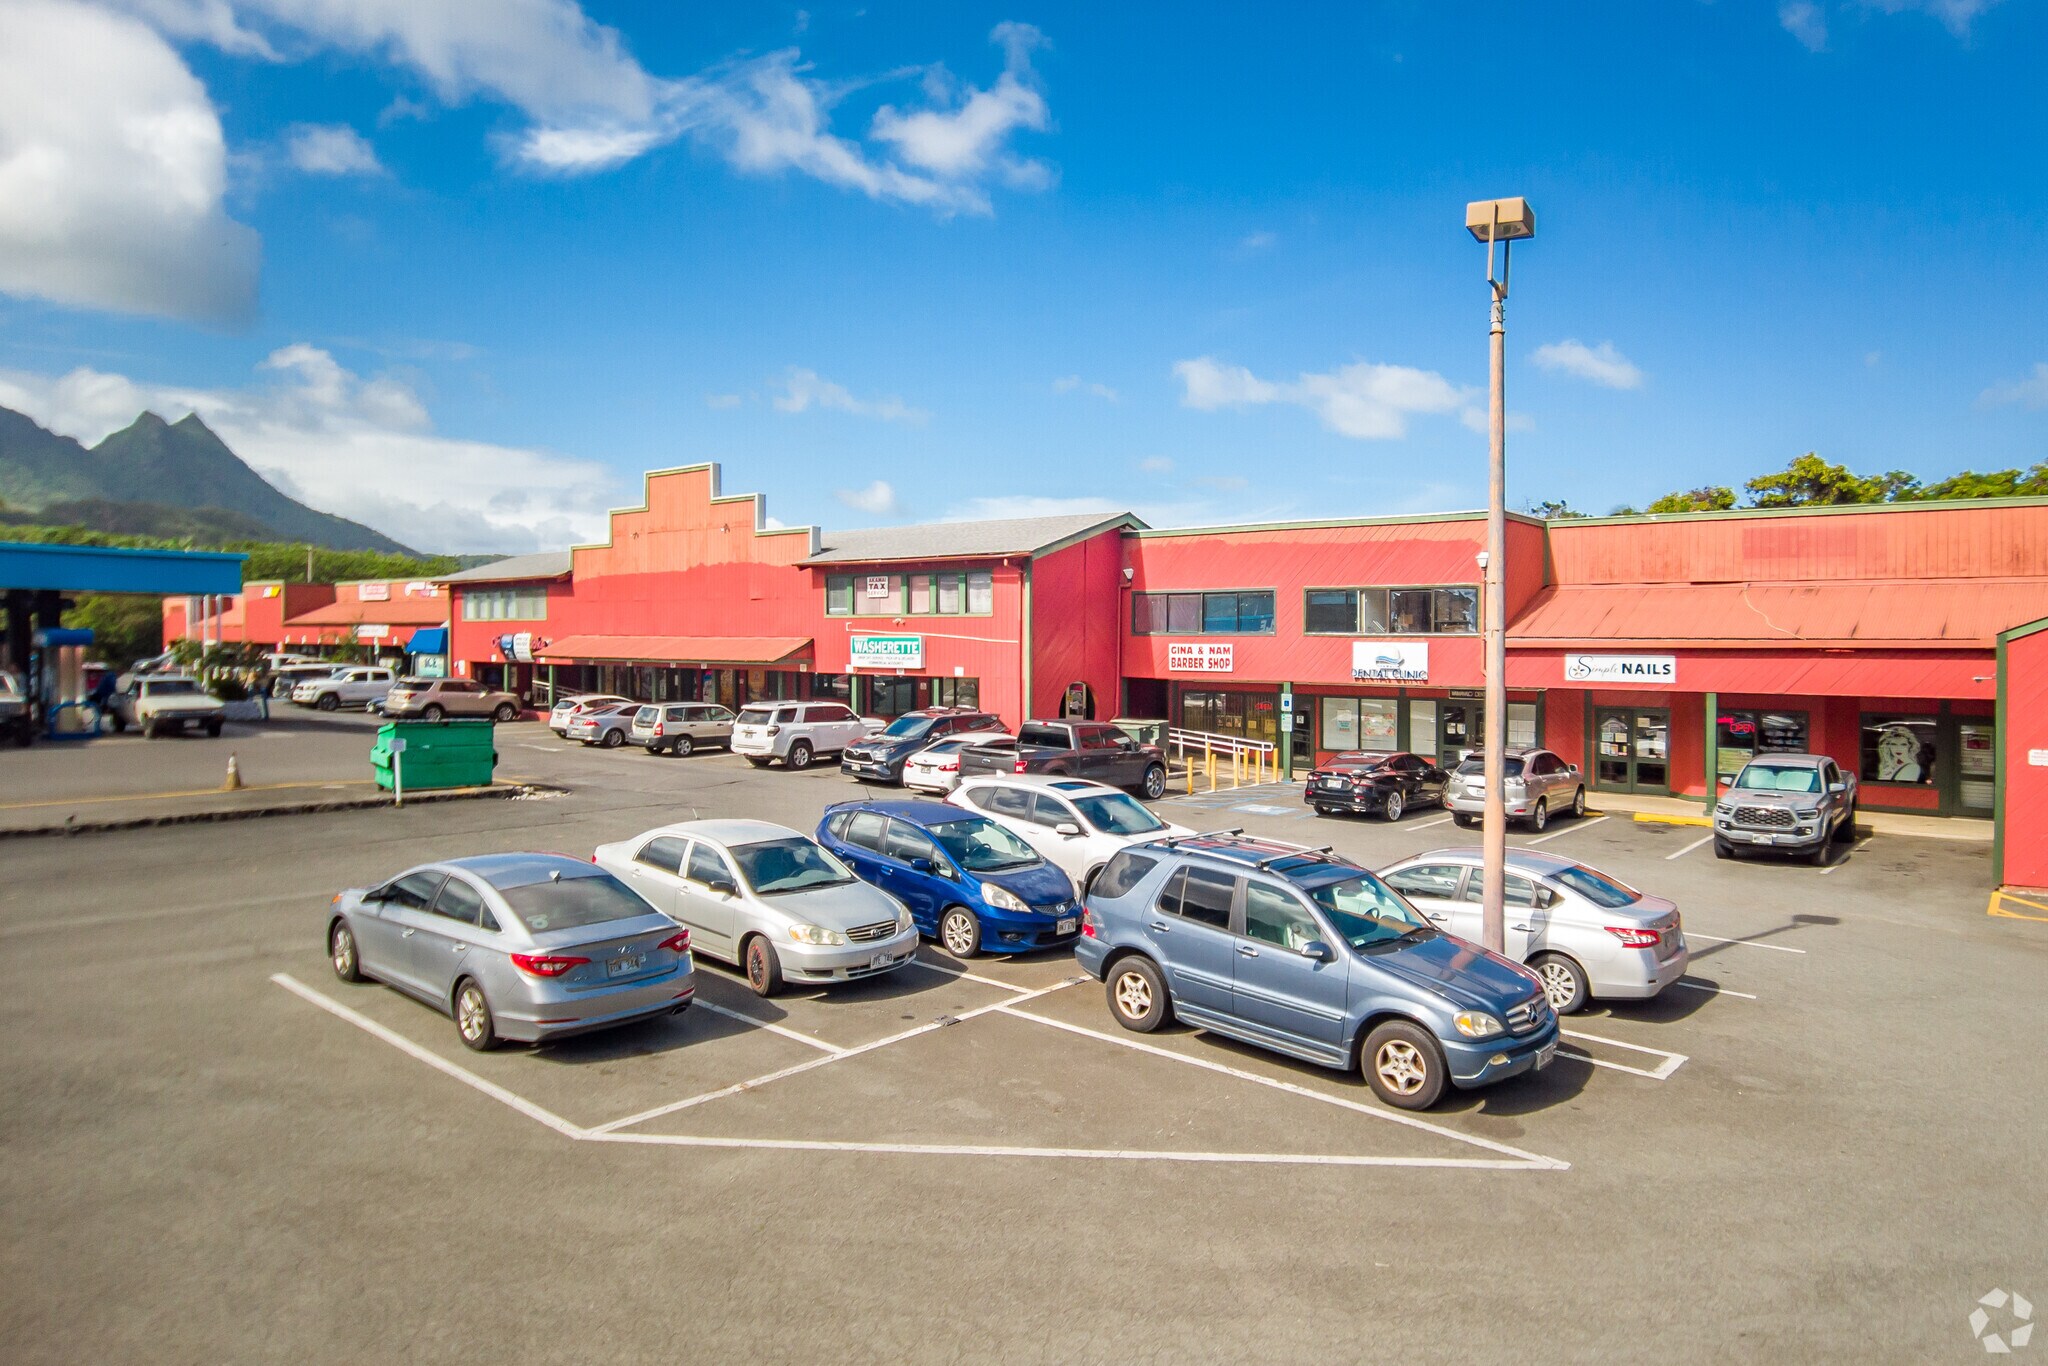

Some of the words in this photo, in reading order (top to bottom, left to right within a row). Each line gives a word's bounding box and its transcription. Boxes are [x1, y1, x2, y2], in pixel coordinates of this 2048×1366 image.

[854, 640, 920, 655] WASHERETTE
[1171, 646, 1193, 655] GINA
[1198, 646, 1204, 655] &
[1209, 646, 1231, 655] NAM
[1171, 657, 1204, 668] BARBER
[1208, 658, 1231, 669] SHOP
[1568, 655, 1618, 680] Simple
[1621, 663, 1671, 675] NAILS
[1351, 668, 1389, 678] DENTAL
[1392, 669, 1428, 679] CLINIC
[1730, 722, 1755, 733] OPEN
